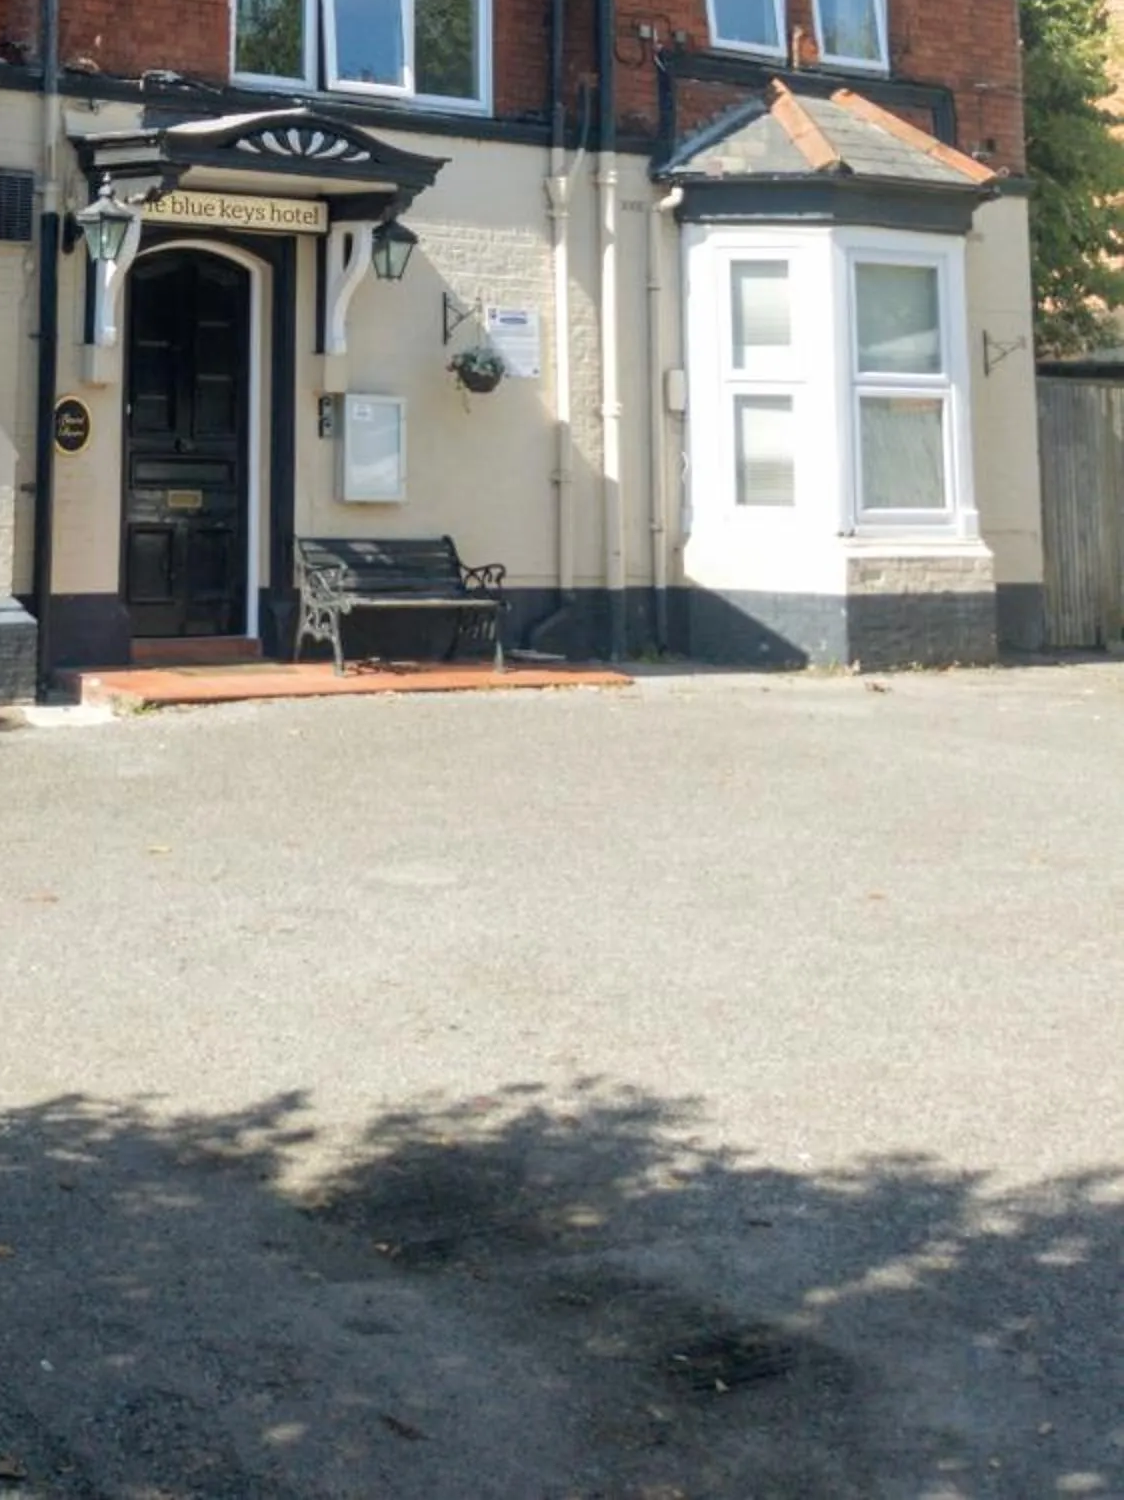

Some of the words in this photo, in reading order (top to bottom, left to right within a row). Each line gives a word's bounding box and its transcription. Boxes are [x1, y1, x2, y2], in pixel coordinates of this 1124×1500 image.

[171, 195, 216, 217] blue
[220, 199, 267, 223] keys
[271, 202, 319, 225] hotel
